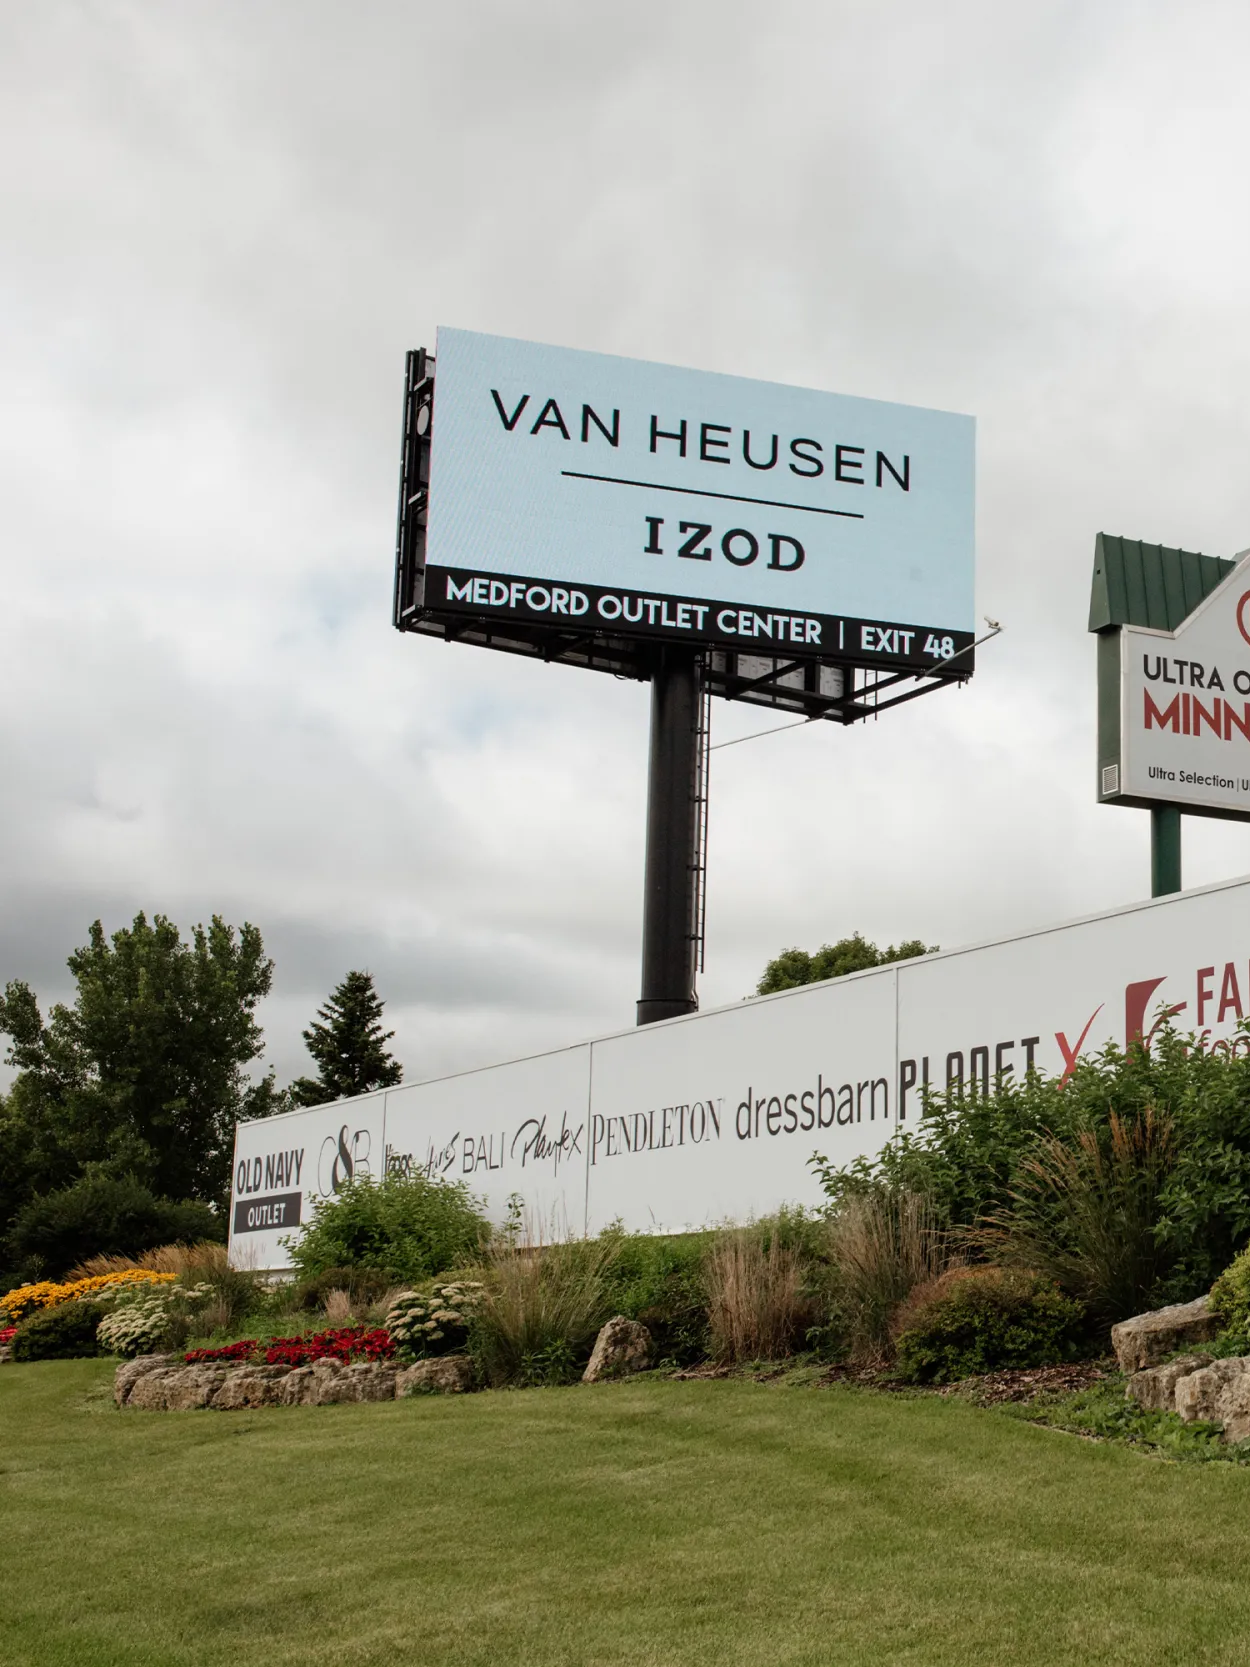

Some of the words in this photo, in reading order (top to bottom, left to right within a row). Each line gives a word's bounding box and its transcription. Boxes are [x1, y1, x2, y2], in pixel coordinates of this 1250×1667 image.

[490, 389, 620, 447] VAN
[649, 414, 910, 492] HEUSEN
[643, 516, 806, 572] IZOD
[446, 574, 589, 615] MEDFORD
[597, 594, 710, 630] OUTLET
[716, 609, 822, 645] CENTER
[860, 625, 915, 655] EXIT
[922, 633, 955, 660] 48
[1143, 654, 1225, 691] ULTRA
[1148, 766, 1175, 781] Ultra
[1179, 770, 1234, 788] Selection
[591, 1098, 725, 1166] PENDLETON
[736, 1074, 888, 1140] dressbarn
[236, 1156, 263, 1195] OLD
[264, 1147, 304, 1190] NAVY
[462, 1132, 505, 1174] BALI
[511, 1110, 583, 1178] Playtex
[247, 1202, 286, 1228] OUTLET
